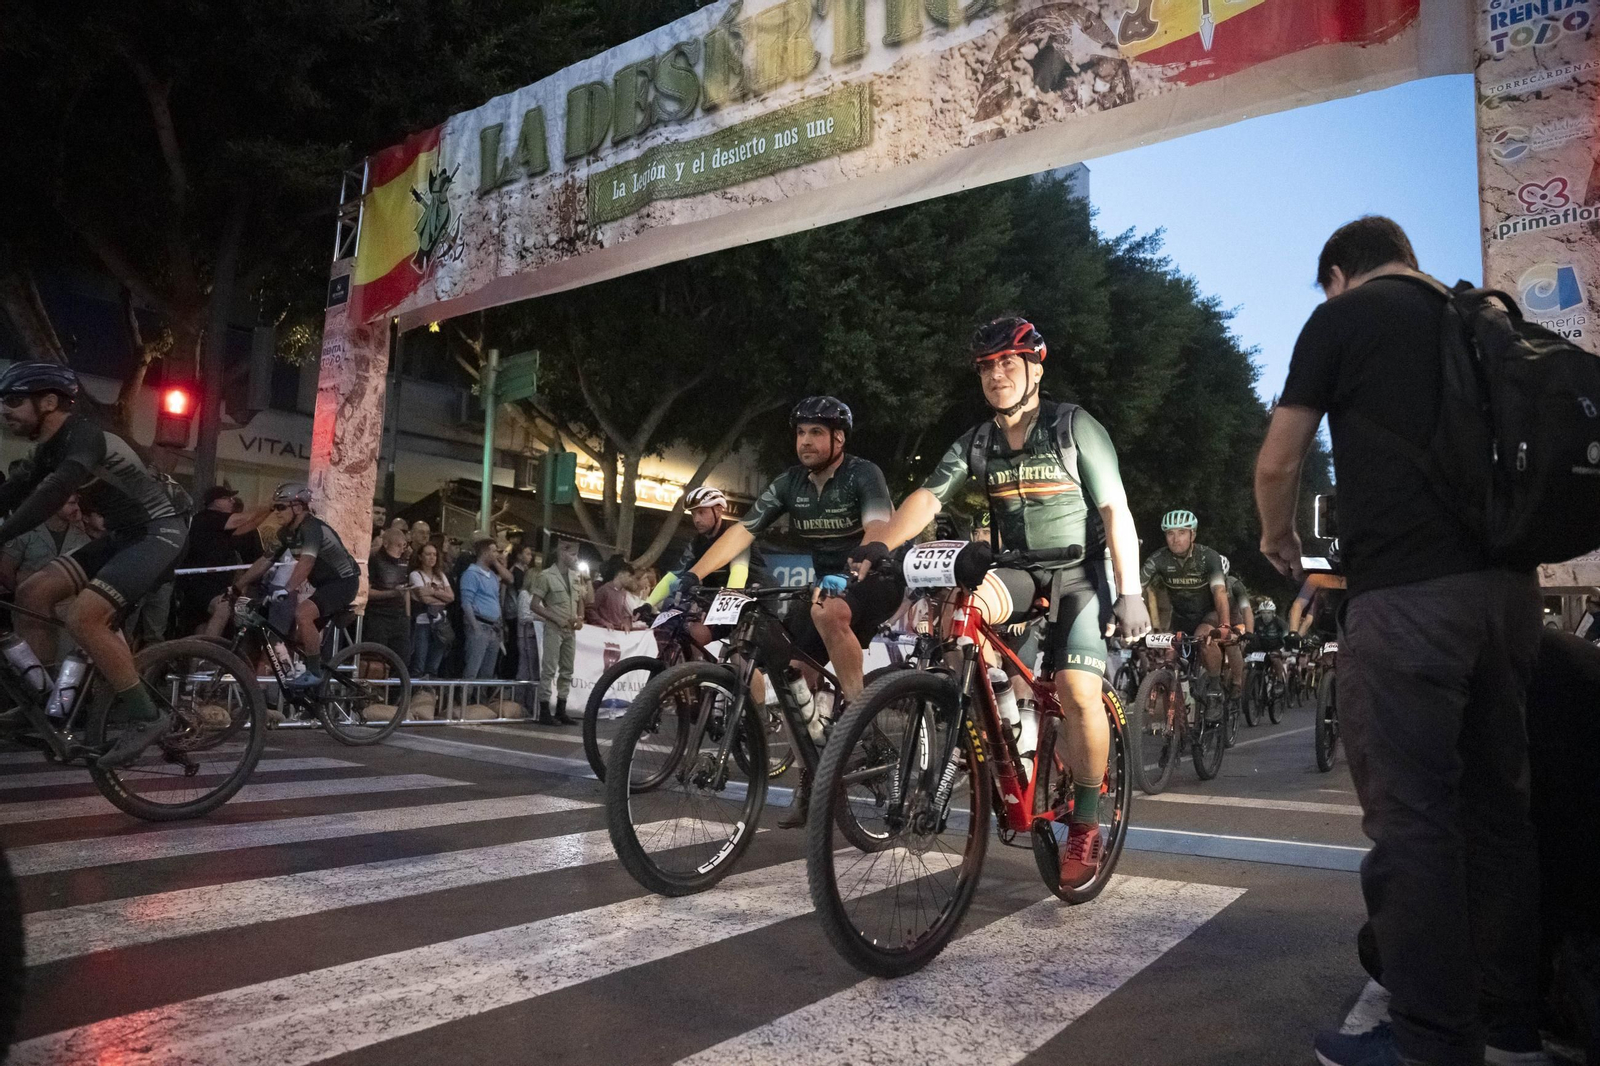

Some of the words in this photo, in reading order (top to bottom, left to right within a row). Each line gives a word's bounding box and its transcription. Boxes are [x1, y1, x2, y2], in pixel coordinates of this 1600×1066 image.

[1490, 10, 1590, 54] TODO
[478, 104, 549, 199] LA
[612, 179, 627, 200] La
[632, 160, 666, 193] Legión
[674, 160, 685, 182] y
[691, 155, 705, 175] el
[711, 136, 767, 169] desierto
[774, 125, 800, 150] nos
[805, 116, 835, 140] une
[1498, 202, 1600, 240] primaflor
[1535, 314, 1586, 329] lmería
[1557, 328, 1583, 340] iva
[913, 549, 956, 571] 5978
[716, 597, 746, 612] 5874
[1067, 653, 1081, 664] LA
[1107, 690, 1127, 726] MAXXIS
[965, 719, 986, 763] AXXIS
